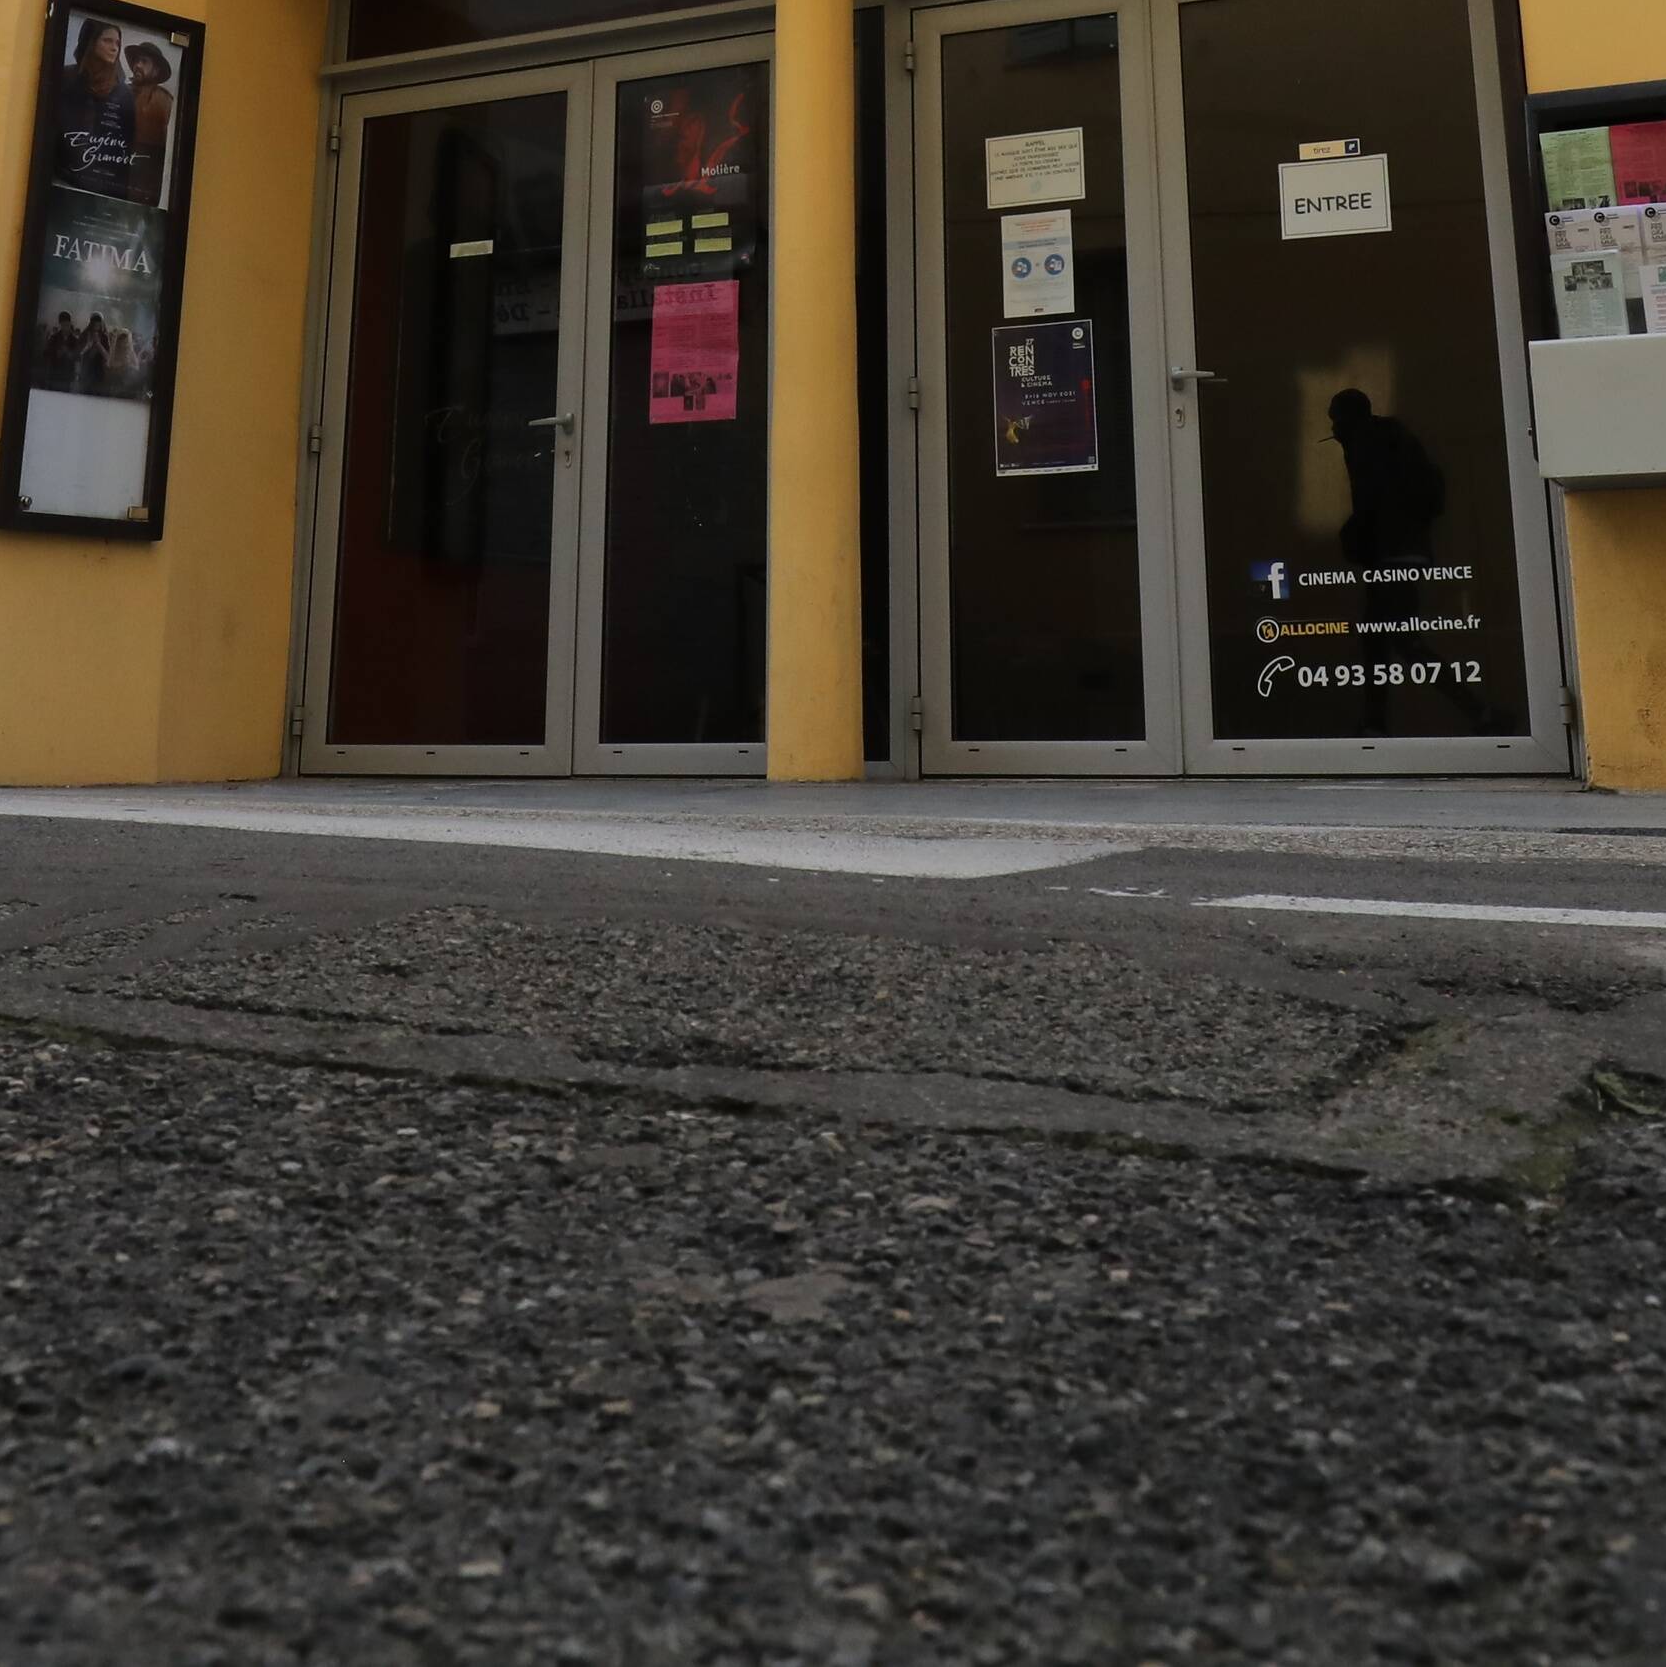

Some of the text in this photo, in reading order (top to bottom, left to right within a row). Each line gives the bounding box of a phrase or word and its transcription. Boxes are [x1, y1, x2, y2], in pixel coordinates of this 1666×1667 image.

[63, 130, 128, 151] Eugénie
[71, 144, 151, 172] Grandet
[701, 163, 740, 177] Molière
[1294, 192, 1372, 214] ENTREE
[53, 234, 152, 275] FATIMA
[1008, 355, 1035, 367] CON
[1009, 345, 1035, 357] REN
[1009, 365, 1036, 377] TRES
[1298, 571, 1356, 586] CINEMA
[1362, 567, 1420, 583] CASINO
[1422, 565, 1473, 581] VENCE
[1280, 621, 1350, 636] ALLOCINE
[1356, 614, 1481, 634] www.allocine.fr
[1297, 660, 1482, 688] 04 93 58 07 12
